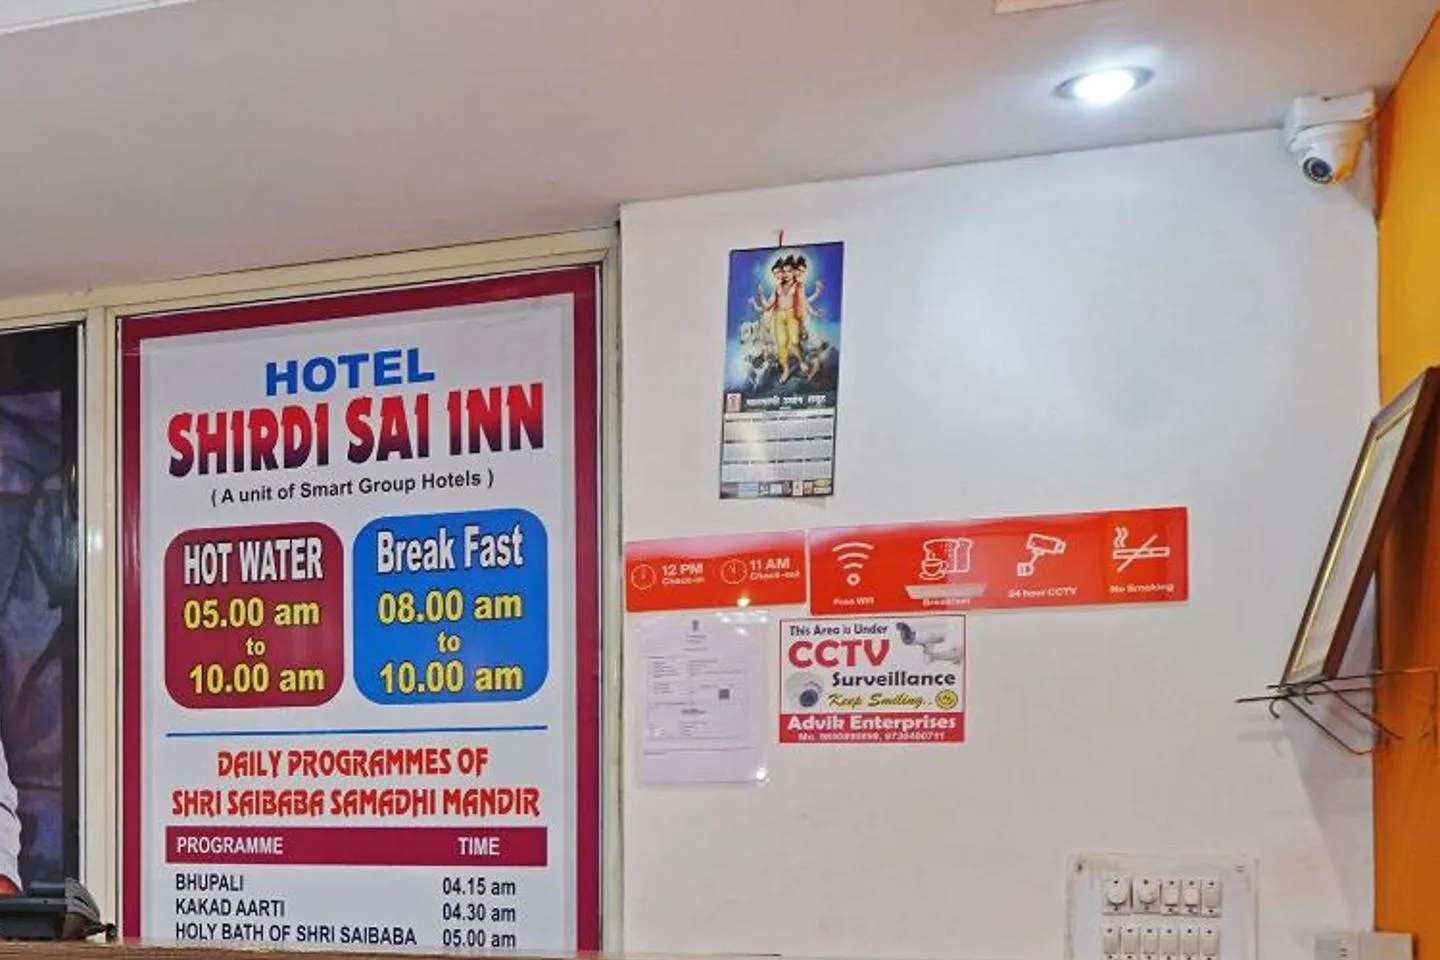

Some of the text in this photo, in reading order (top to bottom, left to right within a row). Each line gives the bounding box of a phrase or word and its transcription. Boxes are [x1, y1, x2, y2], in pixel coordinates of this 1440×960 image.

[265, 348, 435, 397] HOTEL
[167, 382, 545, 478] SHIRDI SAI INN
[239, 484, 273, 503] unit
[277, 482, 296, 500] of
[300, 478, 353, 499] Smart
[358, 476, 416, 497] Group
[422, 470, 482, 490] Hotels
[376, 521, 524, 575] Break Fast
[183, 537, 324, 586] HOT WATER
[661, 563, 703, 576] 12 PM
[750, 558, 790, 571] 11 AM
[1047, 586, 1077, 597] CCTV
[1110, 583, 1174, 593] No Smoking
[183, 597, 320, 630] 05.00 am
[378, 589, 523, 625] 08.00 am
[789, 621, 888, 636] This Area is Under
[246, 636, 267, 657] to
[437, 631, 461, 653] to
[788, 638, 890, 668] CCTV
[189, 663, 326, 695] 10.00 am
[379, 661, 524, 695] 10.00 am
[832, 670, 956, 687] Surveillance
[827, 693, 862, 709] Keep
[787, 713, 957, 735] Advik Enterprises
[217, 747, 490, 779] DAILY PROGRAMMES OF
[172, 787, 541, 818] SHRI SAIBABA SAMADHI MANDIR
[176, 835, 283, 855] PROGRAMME
[458, 836, 500, 856] TIME
[175, 873, 244, 892] BHUPALI
[442, 877, 516, 897] 04.15 am
[175, 898, 285, 918] KAKAD AARTI
[442, 903, 516, 923] 04.30 am
[175, 923, 417, 946] HOLY BATH OF SHRI SAIBABA
[442, 929, 516, 949] 05.00 am
